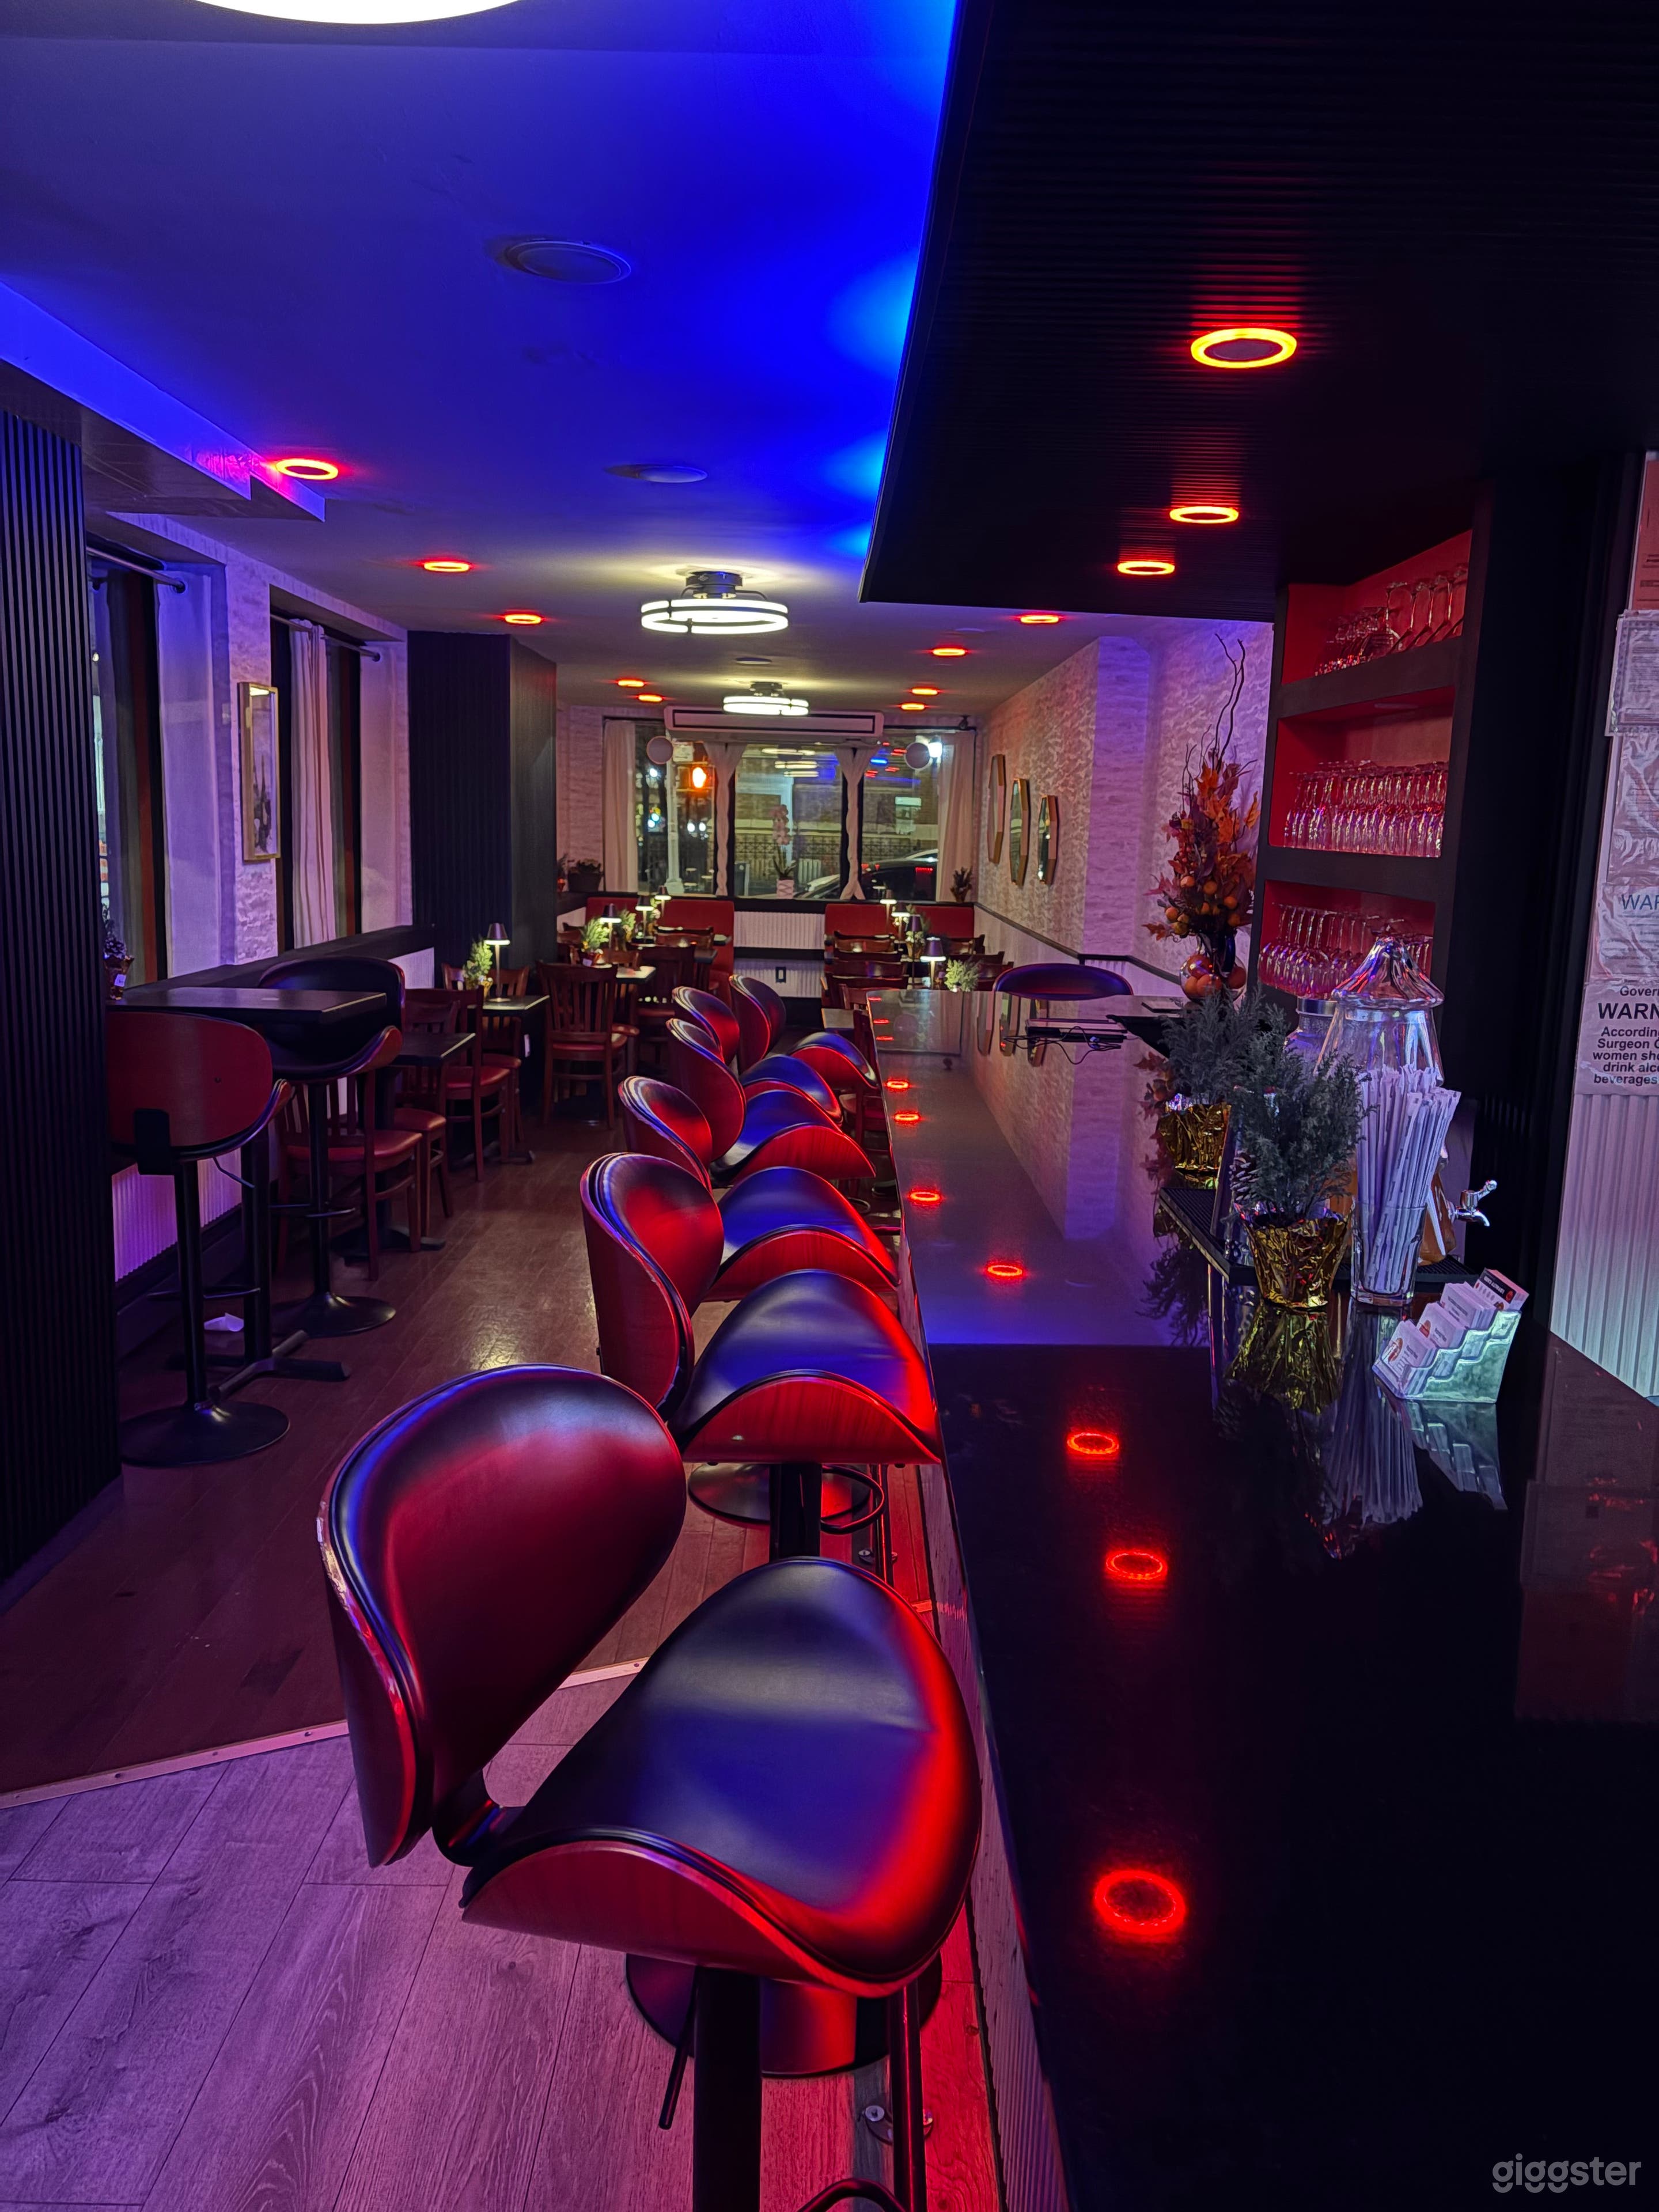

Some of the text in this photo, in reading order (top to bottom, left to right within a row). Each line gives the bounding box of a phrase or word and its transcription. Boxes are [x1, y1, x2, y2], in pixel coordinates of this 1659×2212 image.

[1620, 986, 1659, 997] Gover
[1601, 1027, 1659, 1038] Accordin
[1597, 1038, 1650, 1051] Surgeon
[1593, 1052, 1637, 1060] women
[1603, 1062, 1659, 1073] drink alc
[1594, 1074, 1658, 1086] beverages
